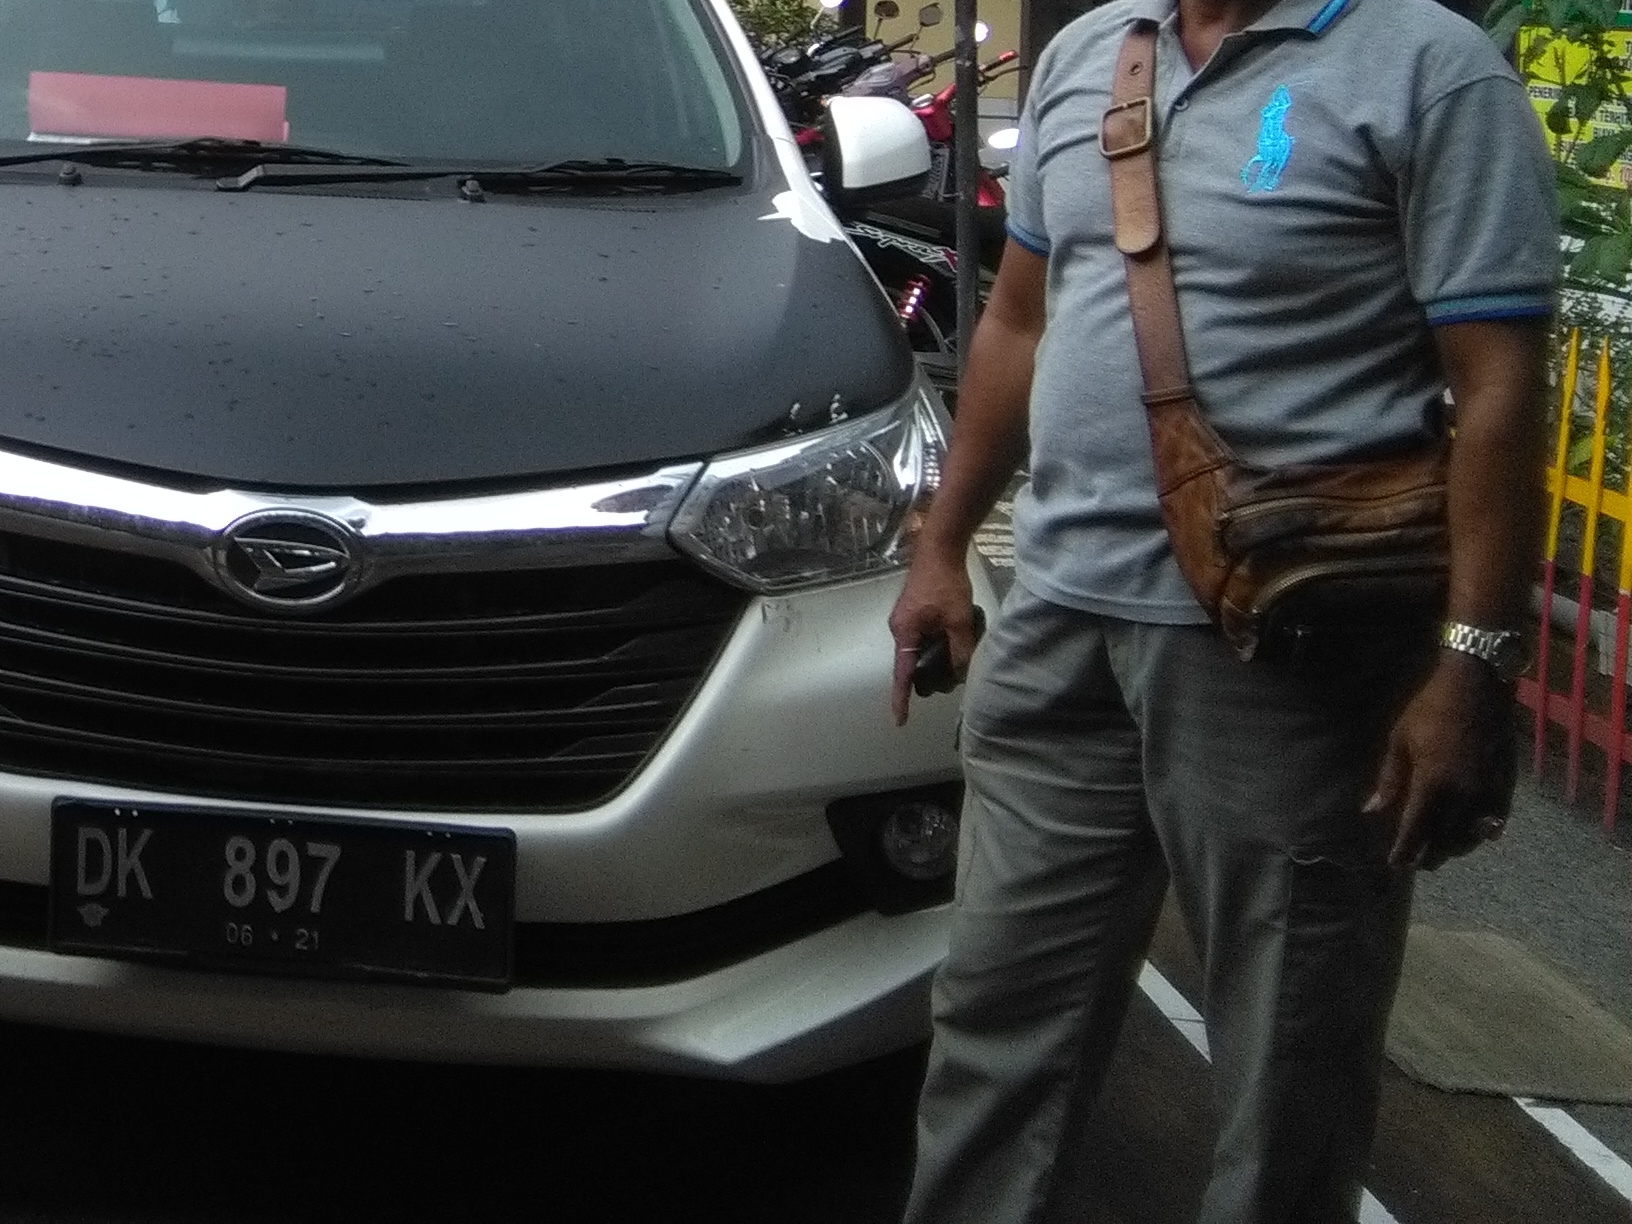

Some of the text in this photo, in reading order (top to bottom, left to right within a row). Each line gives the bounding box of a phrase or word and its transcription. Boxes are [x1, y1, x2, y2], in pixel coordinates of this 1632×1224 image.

[75, 826, 488, 931] DK 897 KX
